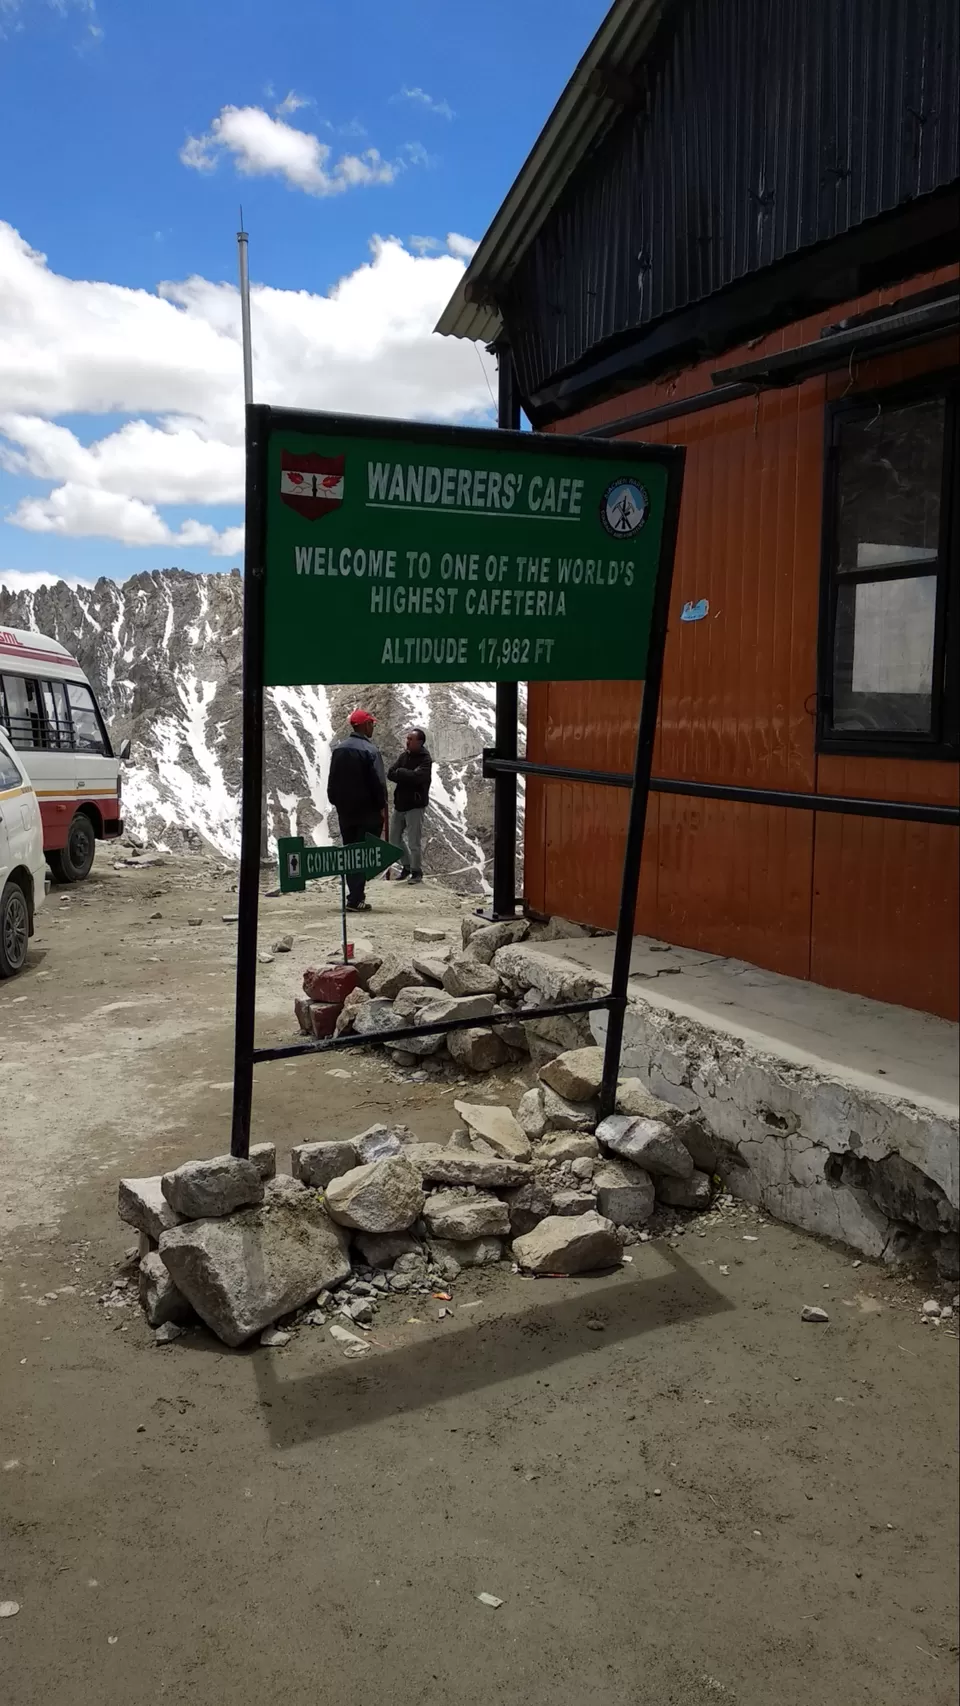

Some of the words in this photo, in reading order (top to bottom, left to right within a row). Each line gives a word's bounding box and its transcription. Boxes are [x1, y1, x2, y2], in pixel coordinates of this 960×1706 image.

[367, 462, 523, 510] WANDERERS'
[528, 476, 584, 514] CAFE
[295, 546, 397, 577] WELCOME
[406, 552, 431, 579] TO
[441, 553, 479, 581] ONE
[485, 555, 508, 582] OF
[516, 557, 551, 583] THE
[558, 558, 635, 586] WORLD'S
[371, 586, 458, 614] HIGHEST
[465, 589, 566, 616] CAFETERIA
[381, 638, 468, 664] ALTIDUDE
[479, 638, 530, 670] 17,982
[534, 639, 554, 664] FT
[307, 847, 381, 873] CONVENIENCE
